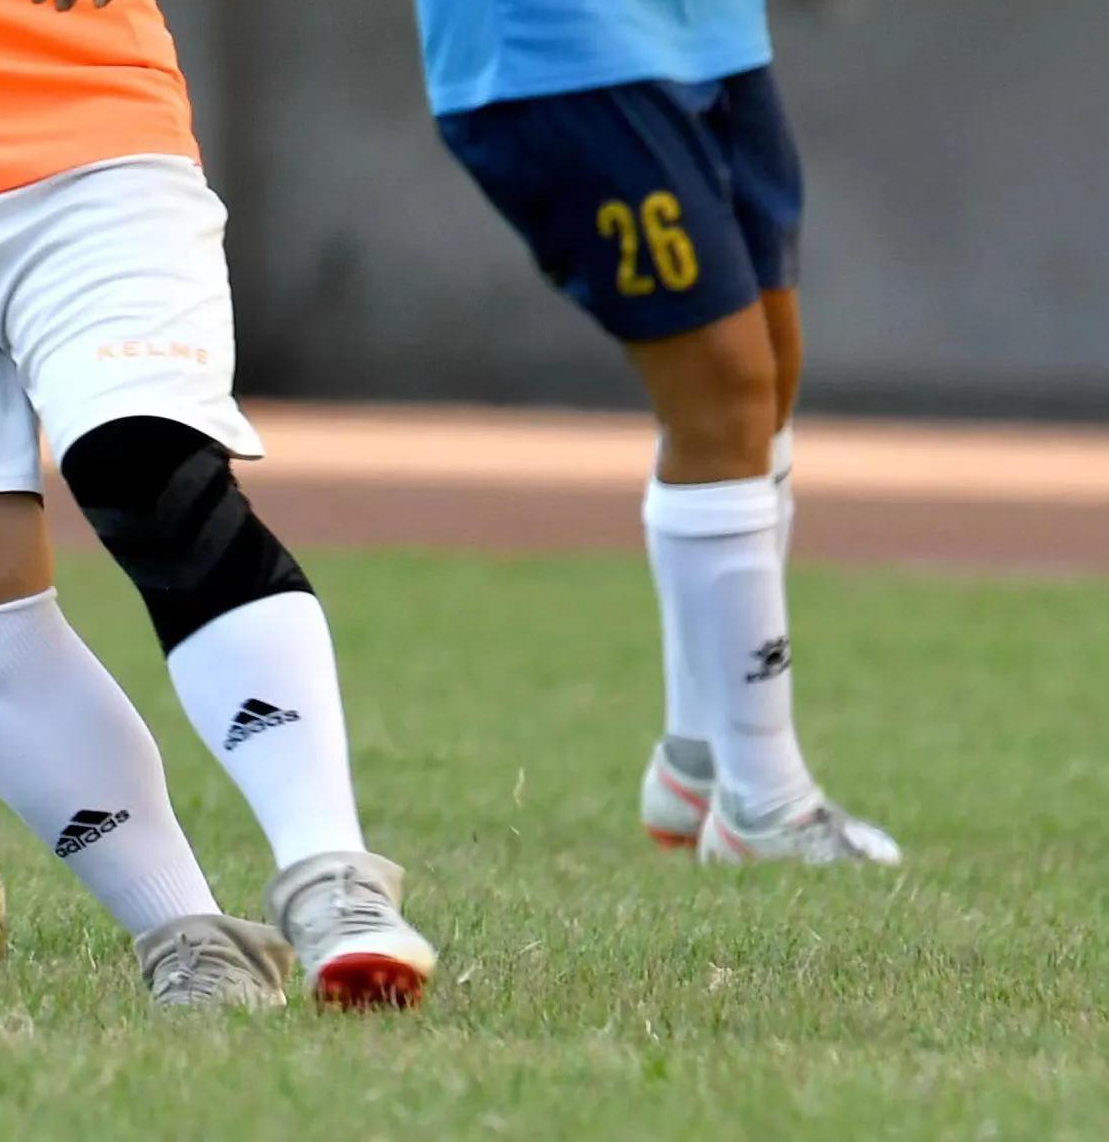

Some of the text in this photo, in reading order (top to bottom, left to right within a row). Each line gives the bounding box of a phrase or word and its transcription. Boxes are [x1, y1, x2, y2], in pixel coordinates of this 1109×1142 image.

[596, 190, 698, 296] 26
[95, 339, 209, 365] KELME
[55, 809, 130, 858] adidas
